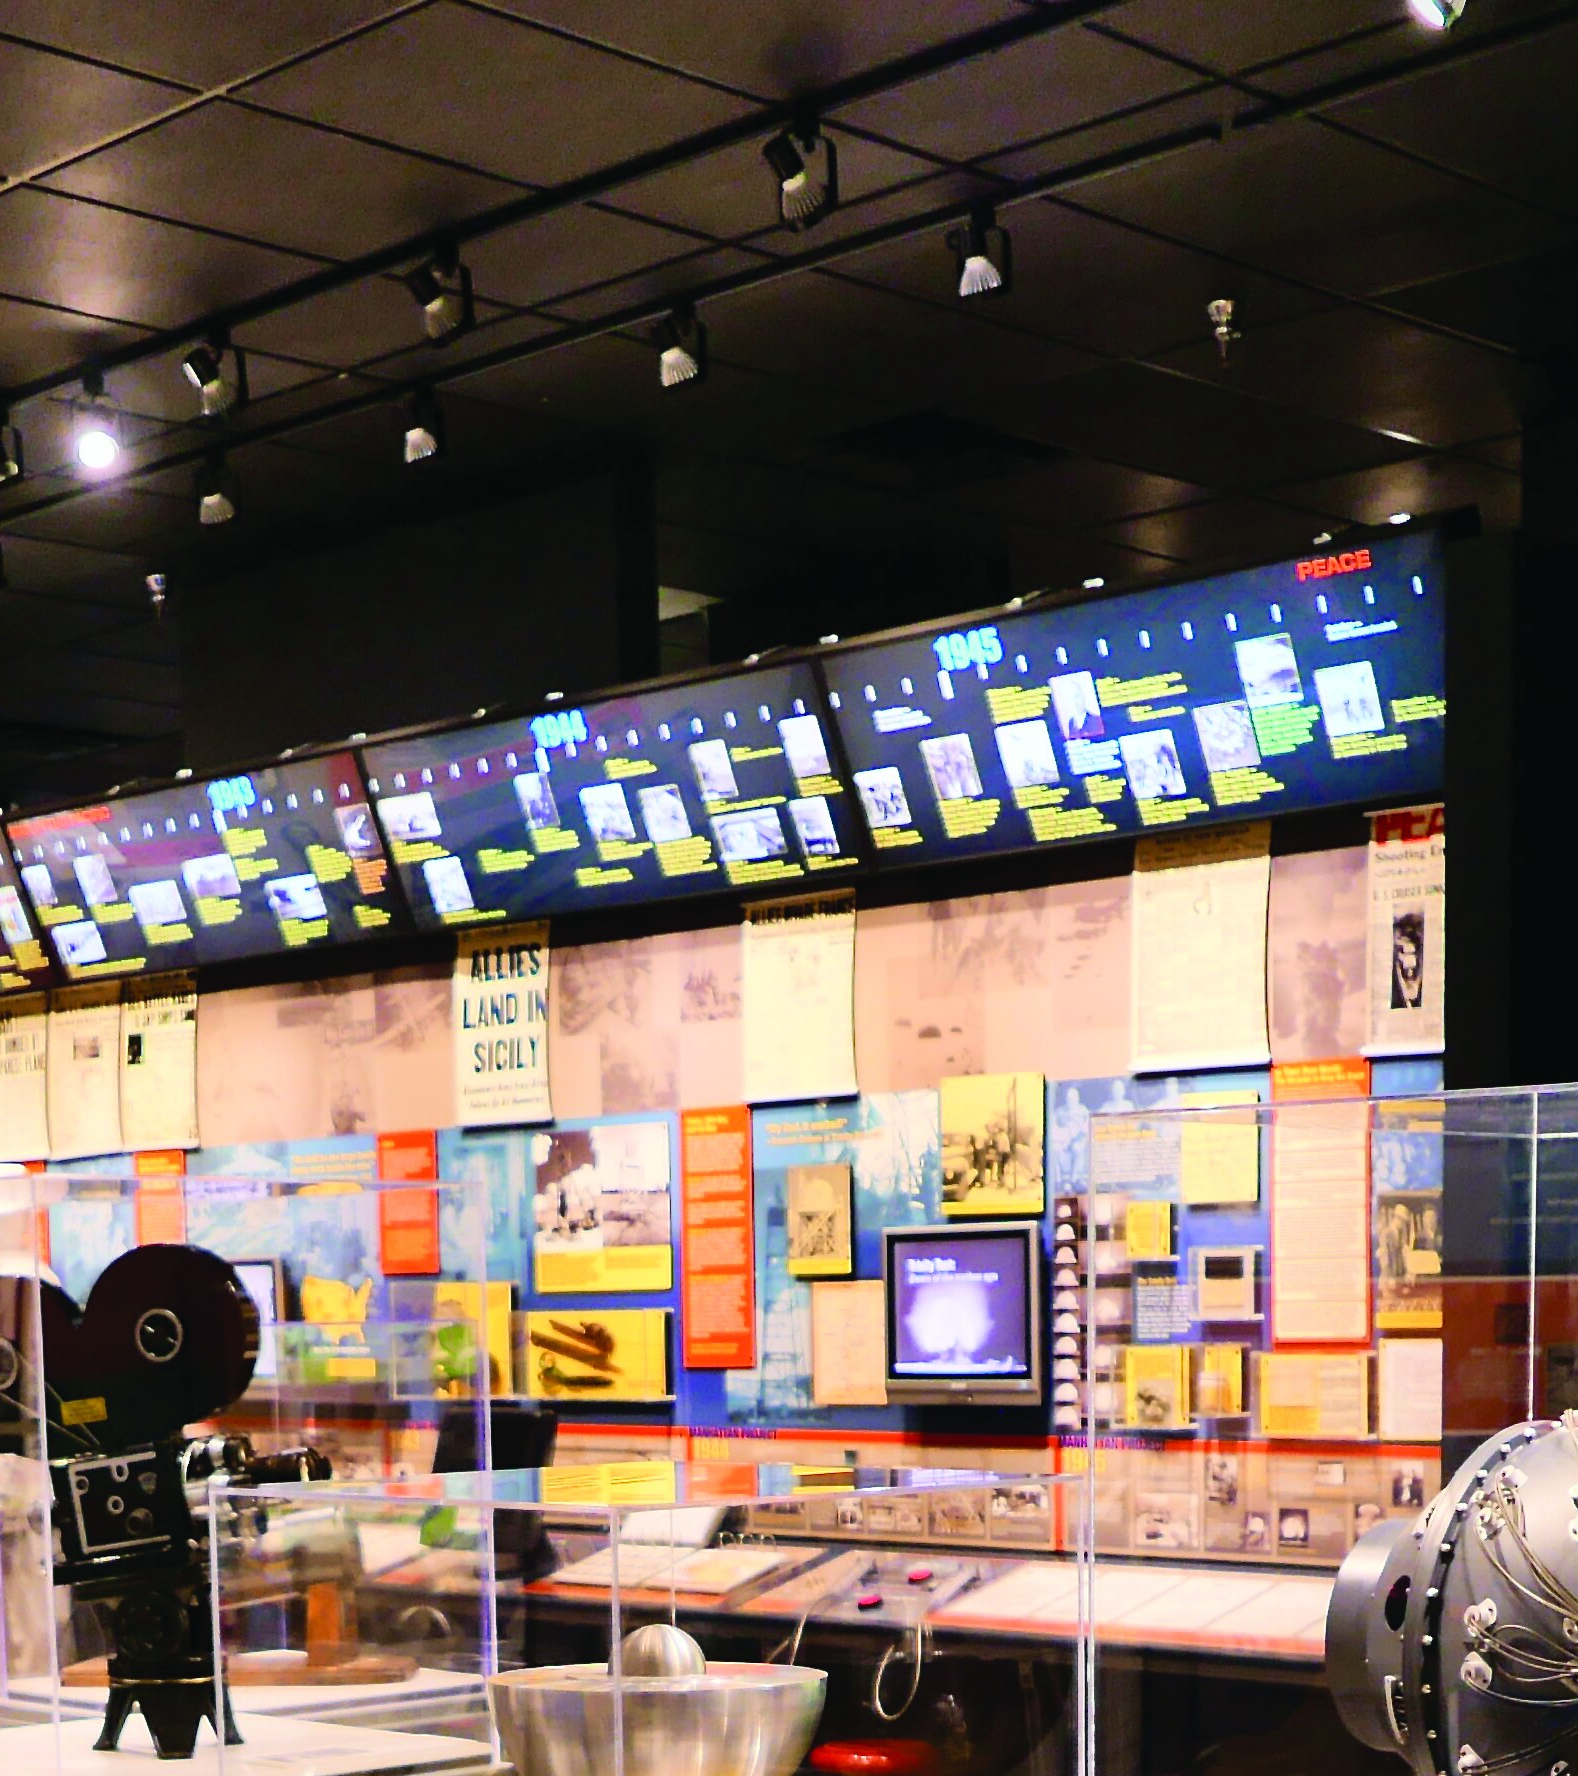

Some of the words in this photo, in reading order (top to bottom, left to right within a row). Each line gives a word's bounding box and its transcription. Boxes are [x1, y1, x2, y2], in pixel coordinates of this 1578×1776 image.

[1296, 549, 1371, 583] PEACE
[933, 626, 1003, 671] 1945
[530, 709, 587, 748] 1944
[472, 943, 541, 982] ALLIES
[463, 992, 517, 1029] LAND
[527, 988, 548, 1022] IN
[474, 1036, 541, 1073] SICILY
[693, 1439, 729, 1459] 1944
